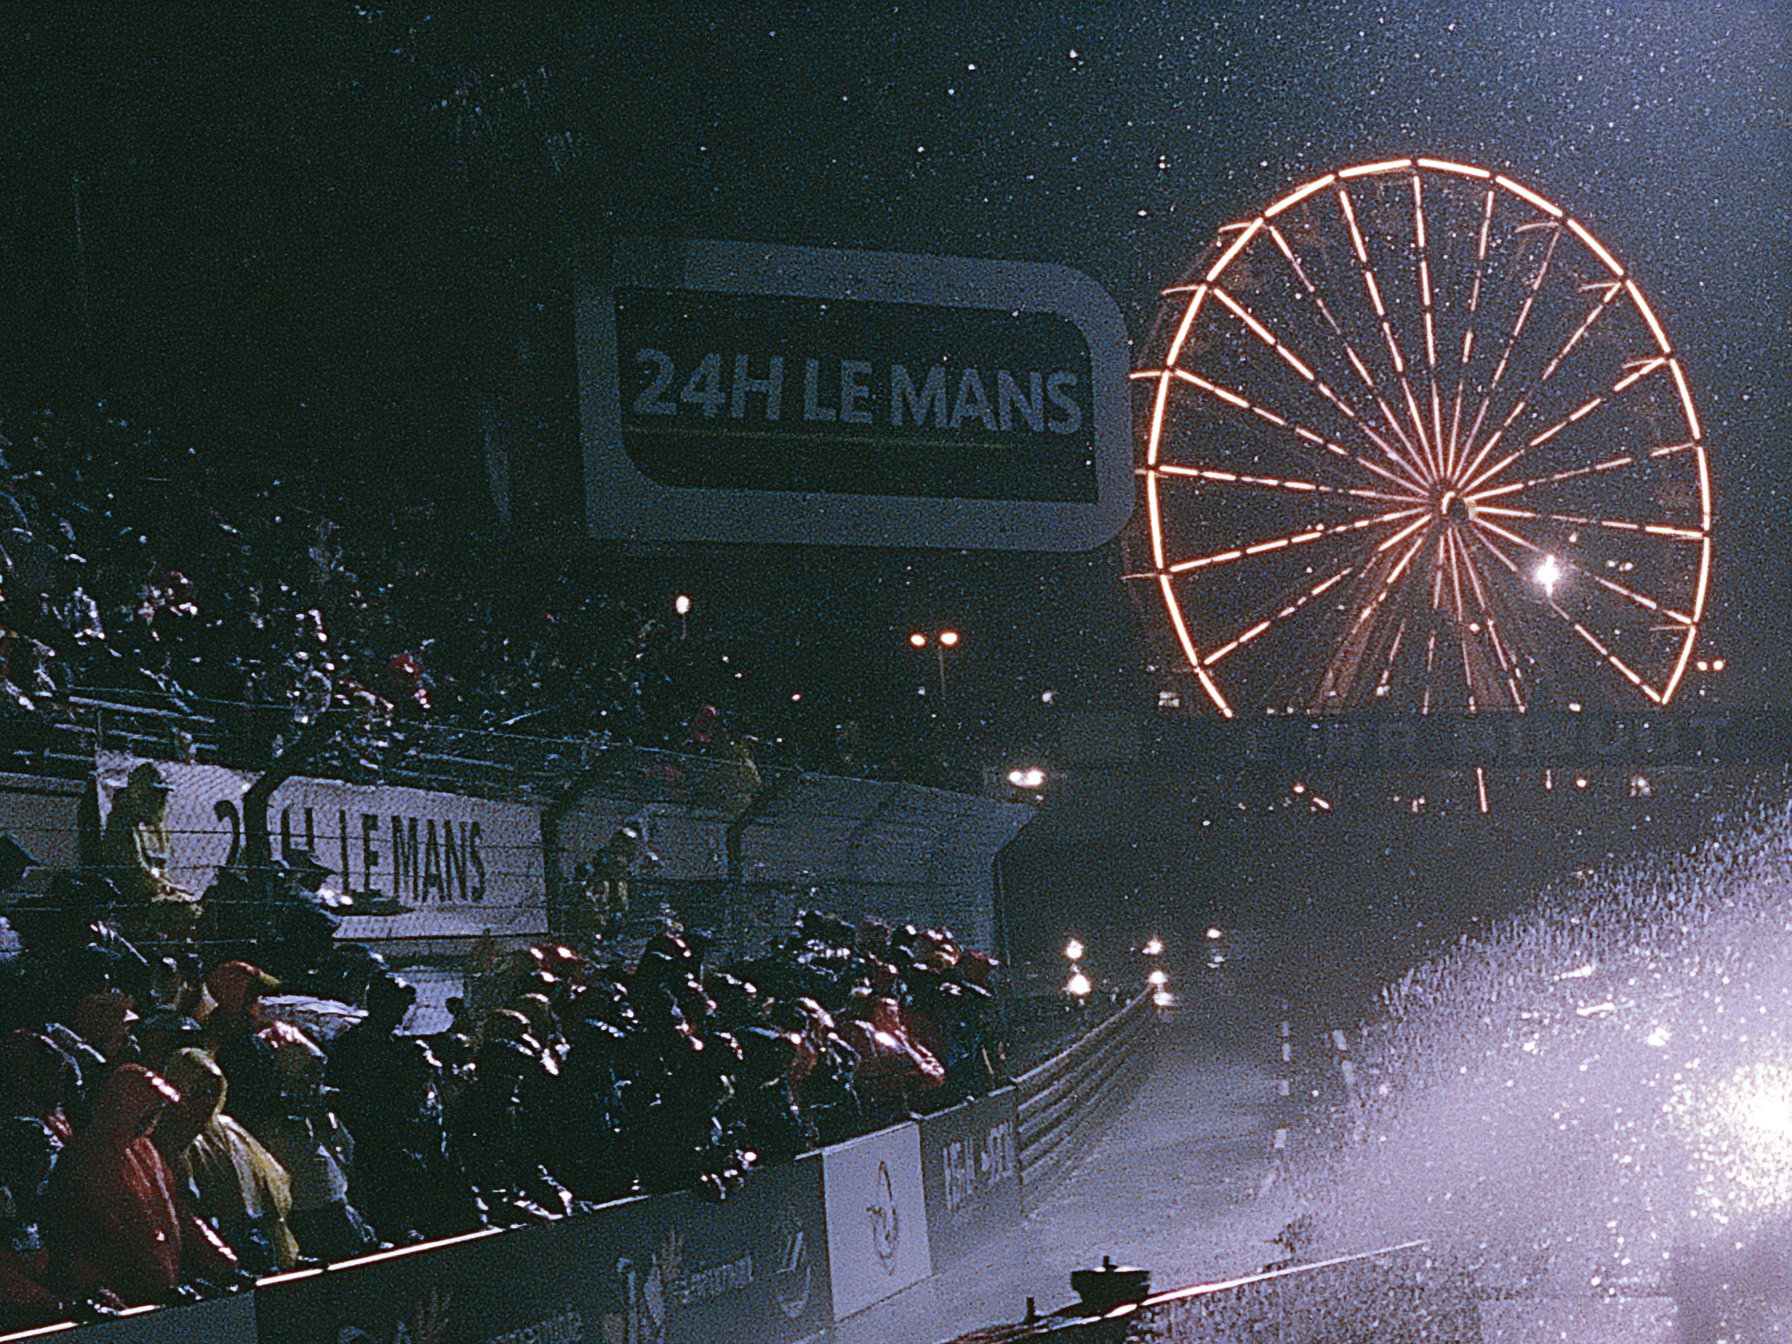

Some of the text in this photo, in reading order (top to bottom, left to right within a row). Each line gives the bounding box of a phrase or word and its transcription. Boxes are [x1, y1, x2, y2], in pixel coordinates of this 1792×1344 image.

[634, 347, 1082, 434] 24H LE MANS
[391, 814, 486, 902] MANS
